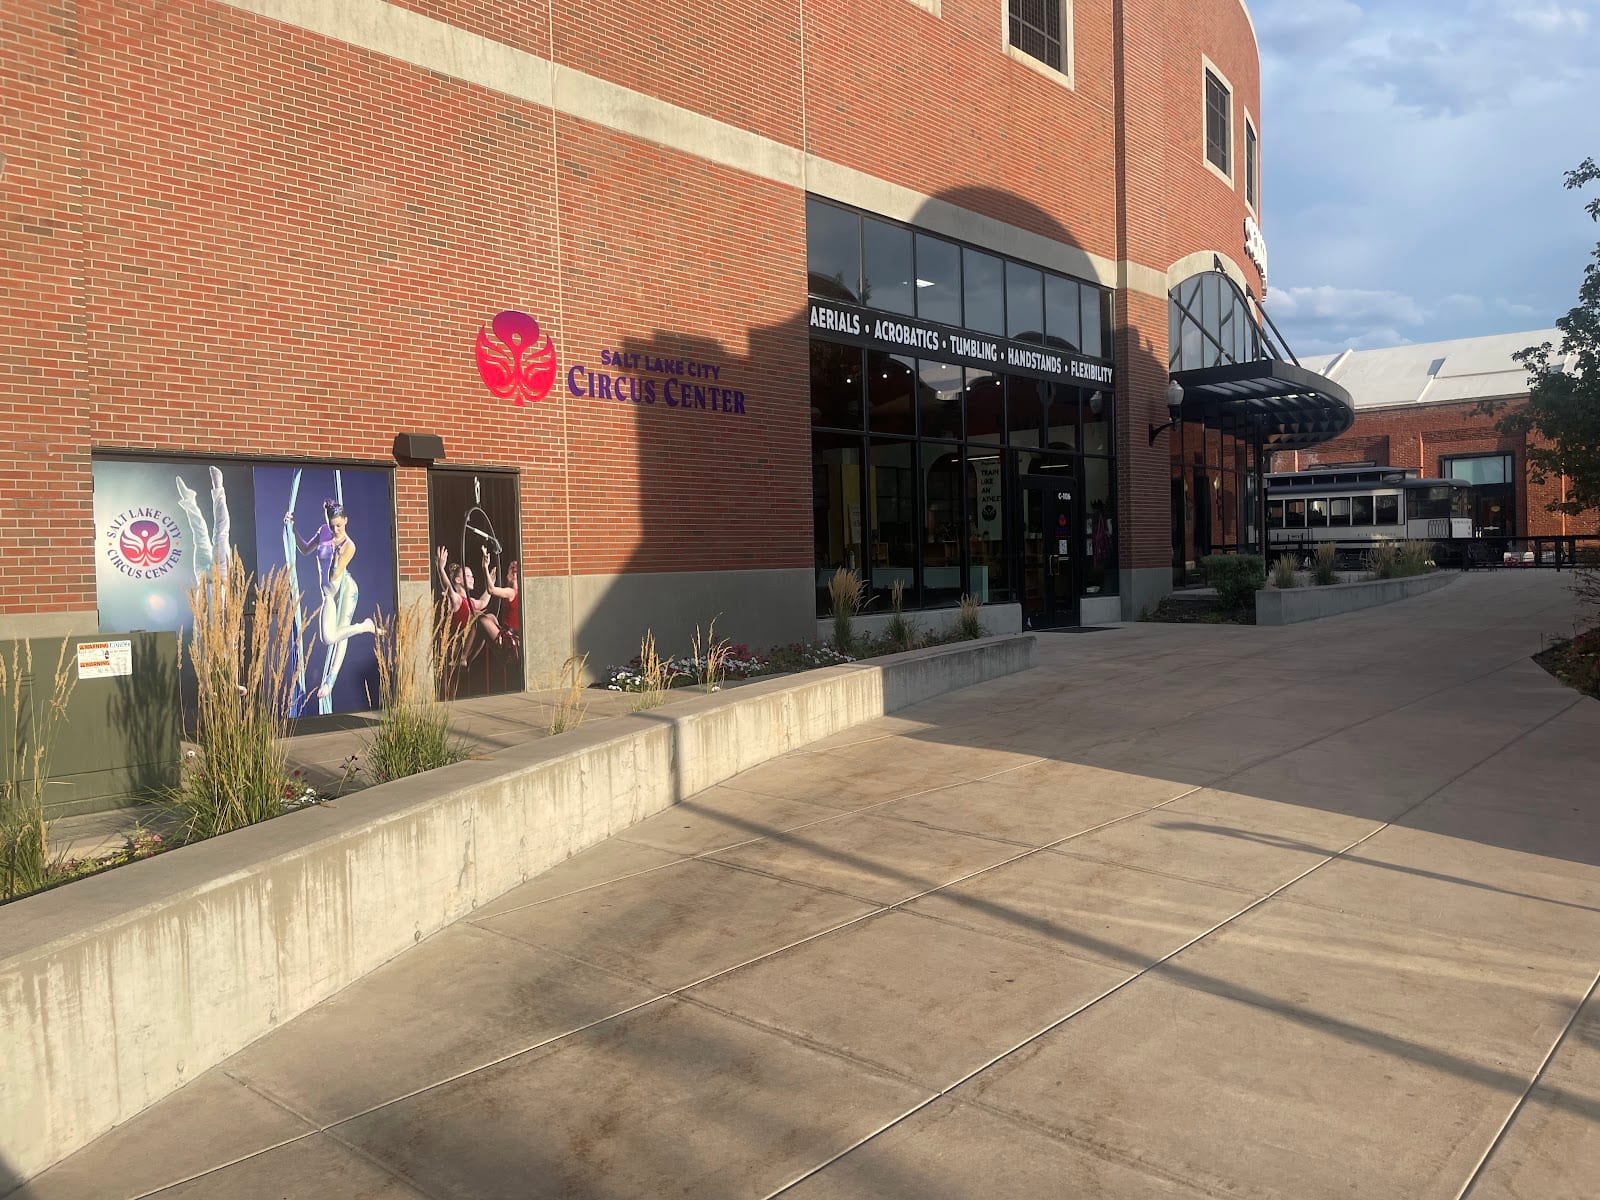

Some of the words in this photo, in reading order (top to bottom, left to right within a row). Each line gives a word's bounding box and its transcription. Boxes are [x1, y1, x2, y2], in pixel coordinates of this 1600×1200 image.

[810, 306, 860, 335] AERIALS
[874, 320, 939, 350] ACROBATICS
[950, 335, 998, 361] TUMBLING
[1008, 347, 1062, 374] HANDSTANDS
[1070, 360, 1113, 384] FLEXIBILITY
[601, 350, 641, 369] SALT
[645, 356, 684, 376] LAKE
[688, 362, 720, 380] CITY
[106, 513, 128, 538] SALT
[128, 508, 162, 520] LAKE
[162, 516, 182, 539] CITY
[107, 549, 142, 579] CIRCUS
[145, 548, 182, 579] CENTER
